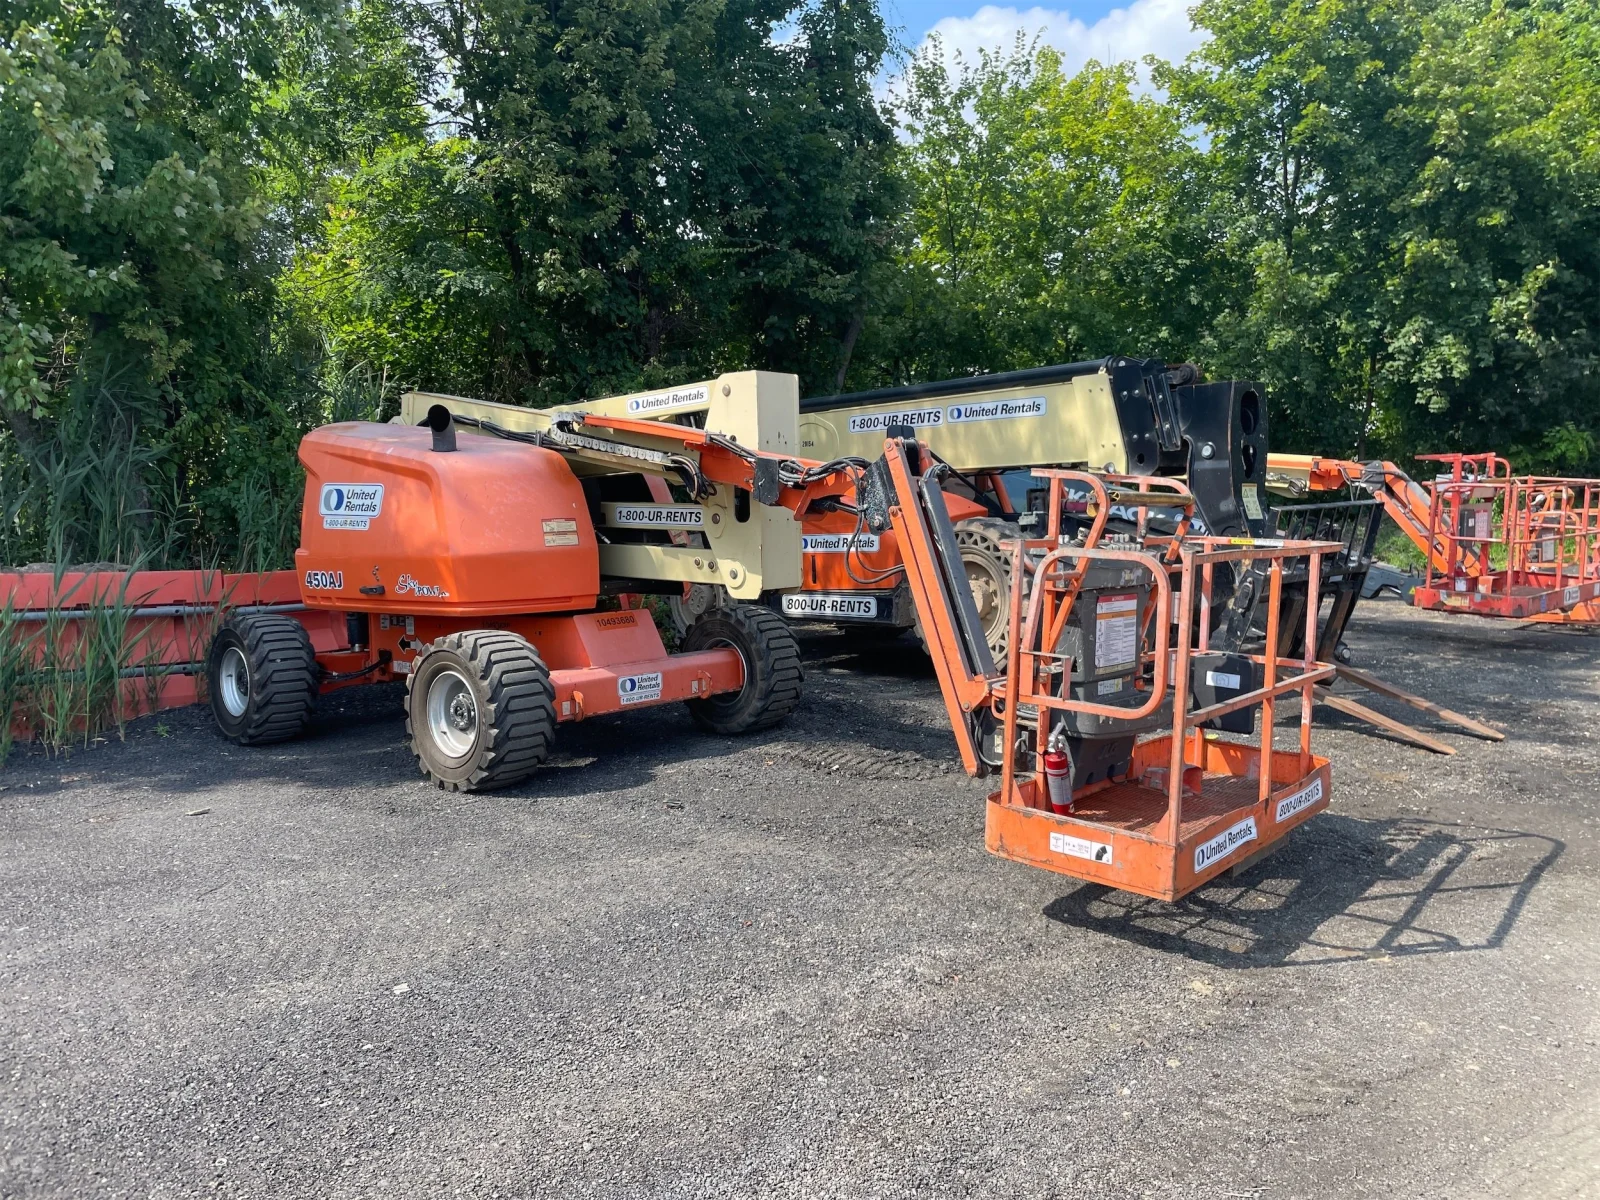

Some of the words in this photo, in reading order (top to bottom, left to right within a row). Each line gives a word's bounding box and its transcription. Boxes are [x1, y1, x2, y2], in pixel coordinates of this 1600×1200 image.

[641, 395, 669, 409] United
[671, 390, 704, 404] Rentals
[964, 405, 998, 418] United
[1000, 401, 1041, 415] Rentals
[851, 410, 941, 430] 1-800-UR-RENTS
[347, 489, 377, 500] United
[344, 501, 376, 512] Rentals
[617, 510, 702, 523] 1-800-UR-RENTS
[325, 519, 367, 528] 1-800-UR-RENTS
[810, 538, 840, 549] United
[842, 537, 875, 548] Rtals
[305, 571, 343, 589] 450AJ
[787, 598, 871, 614] 800-UR-RENTS
[596, 615, 635, 627] 10493680
[637, 675, 658, 684] United
[637, 682, 660, 691] Rentals
[622, 693, 659, 703] 1-800-UR-RENTS
[1279, 783, 1320, 818] 800-UR-RENTS
[1205, 836, 1227, 859] United
[1227, 822, 1253, 847] Rentals
